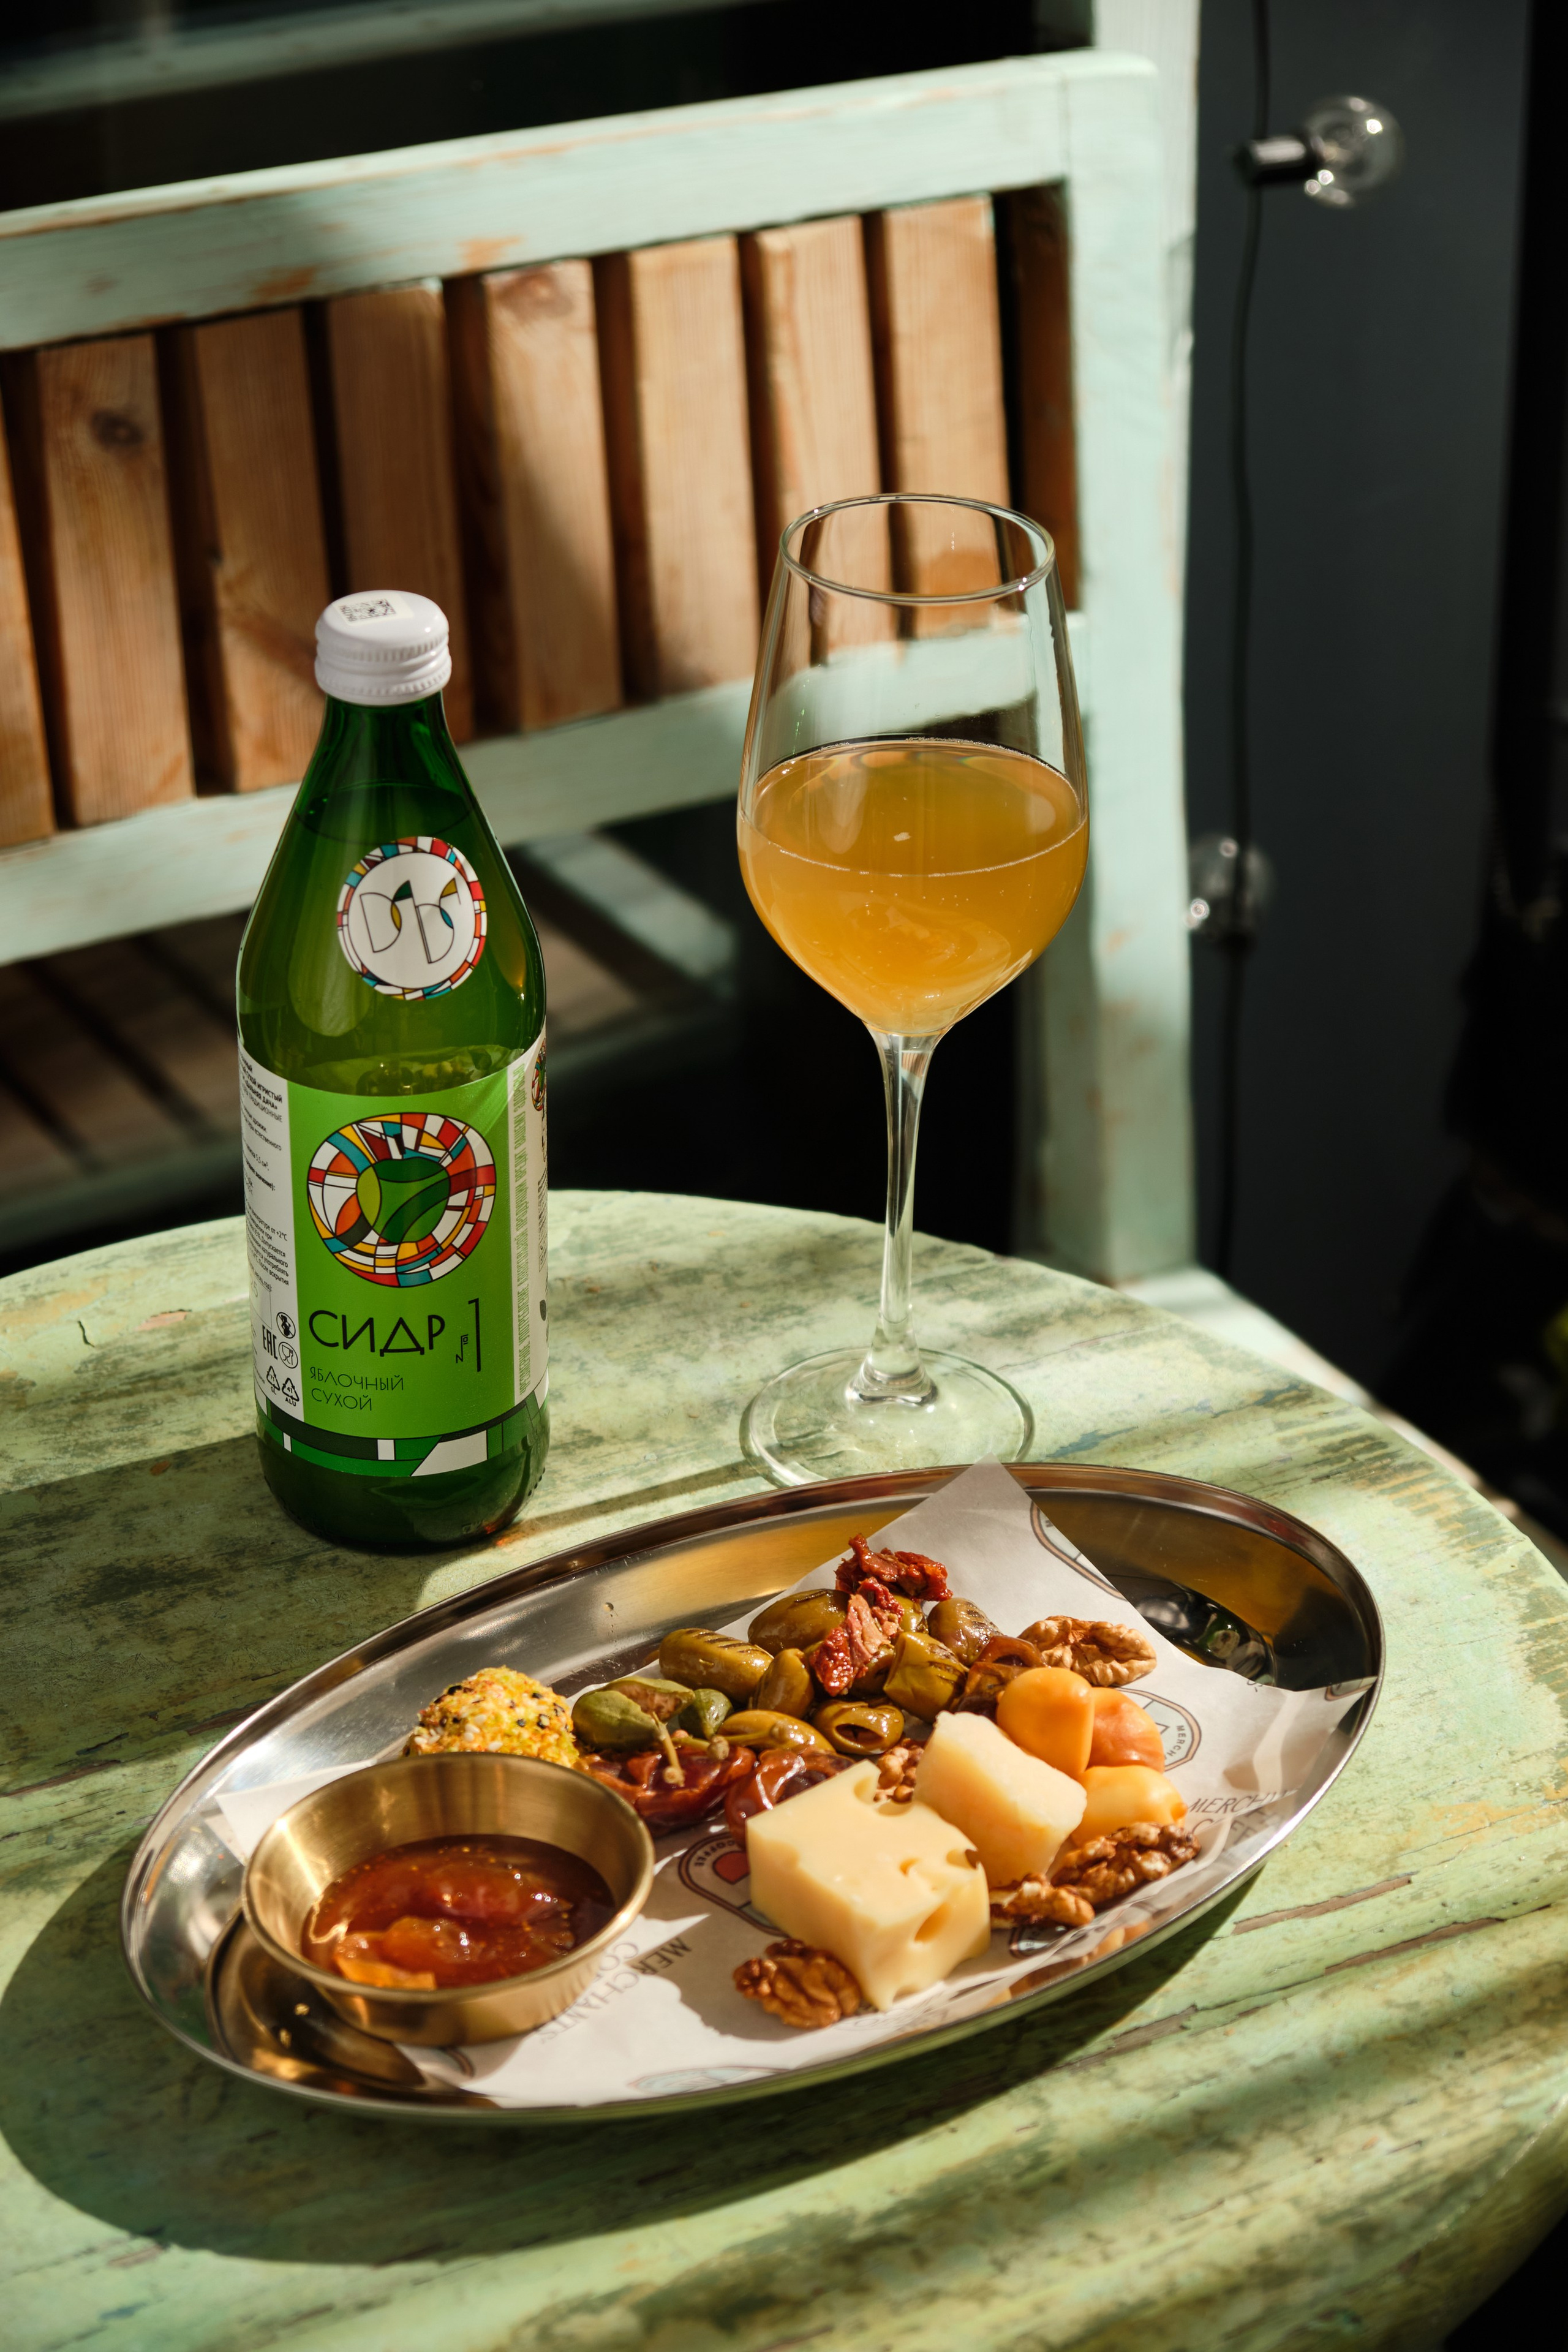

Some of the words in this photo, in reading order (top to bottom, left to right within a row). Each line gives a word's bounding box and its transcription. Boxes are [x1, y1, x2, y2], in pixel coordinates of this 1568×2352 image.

[257, 1083, 282, 1102] ИГРИСТЫЙ
[262, 1096, 277, 1109] ДАЧА»
[262, 1324, 278, 1360] EAC
[309, 1310, 445, 1357] СИДР
[309, 1366, 404, 1391] ЯБЛОЧНЫЙ
[285, 1396, 297, 1407] ALU
[311, 1388, 372, 1411] СУХОЙ
[1163, 1724, 1187, 1760] MERCH
